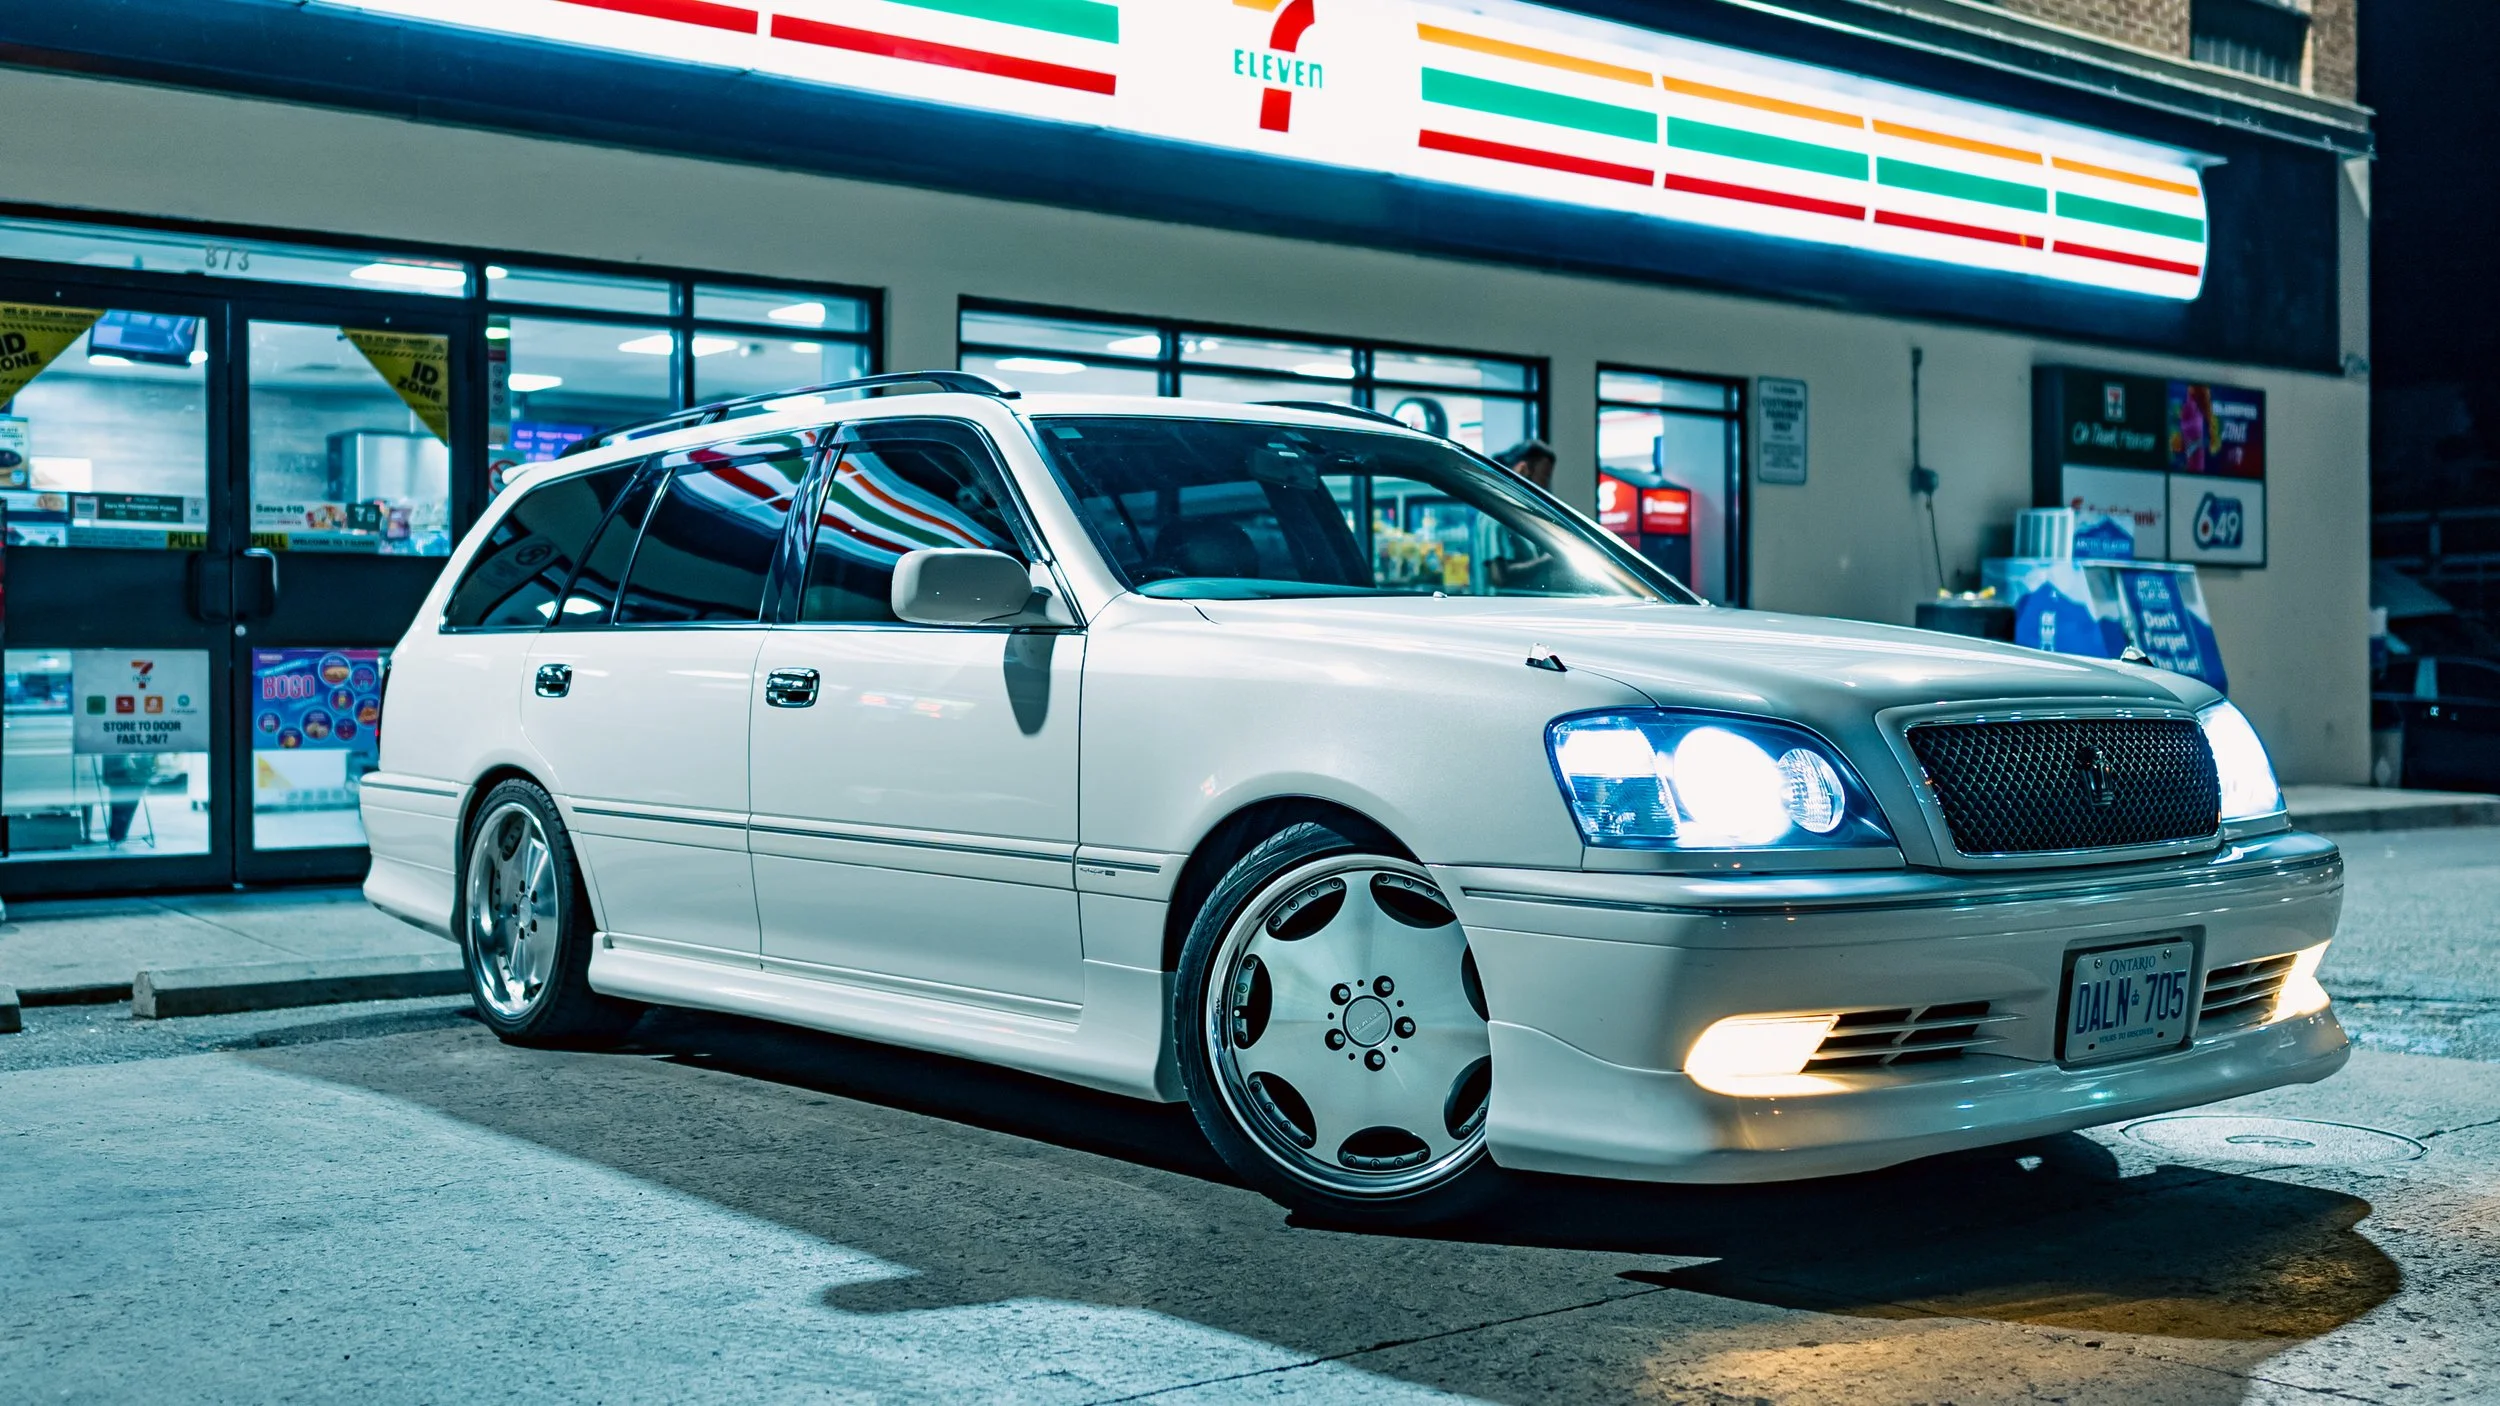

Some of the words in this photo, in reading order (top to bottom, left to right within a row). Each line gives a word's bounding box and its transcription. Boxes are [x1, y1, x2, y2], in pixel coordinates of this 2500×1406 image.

[205, 242, 250, 272] 873
[0, 351, 41, 372] ONE
[411, 361, 438, 385] ID
[397, 376, 441, 403] ZONE
[256, 504, 284, 513] Save
[251, 533, 286, 548] PULL
[293, 538, 330, 546] WELCOME
[2143, 610, 2178, 629] Don't
[2145, 631, 2189, 653] Forget
[263, 674, 315, 699] BOGO
[103, 721, 136, 732] STORE
[138, 721, 151, 731] TO
[153, 721, 181, 732] DOOR
[116, 734, 143, 745] FAST,
[146, 733, 168, 744] 24/7
[2109, 955, 2156, 976] ONTARIO
[2075, 976, 2132, 1034] DALN
[2145, 969, 2187, 1024] 705
[2099, 1034, 2117, 1043] YOURS
[2127, 1027, 2154, 1038] DISCOVER
